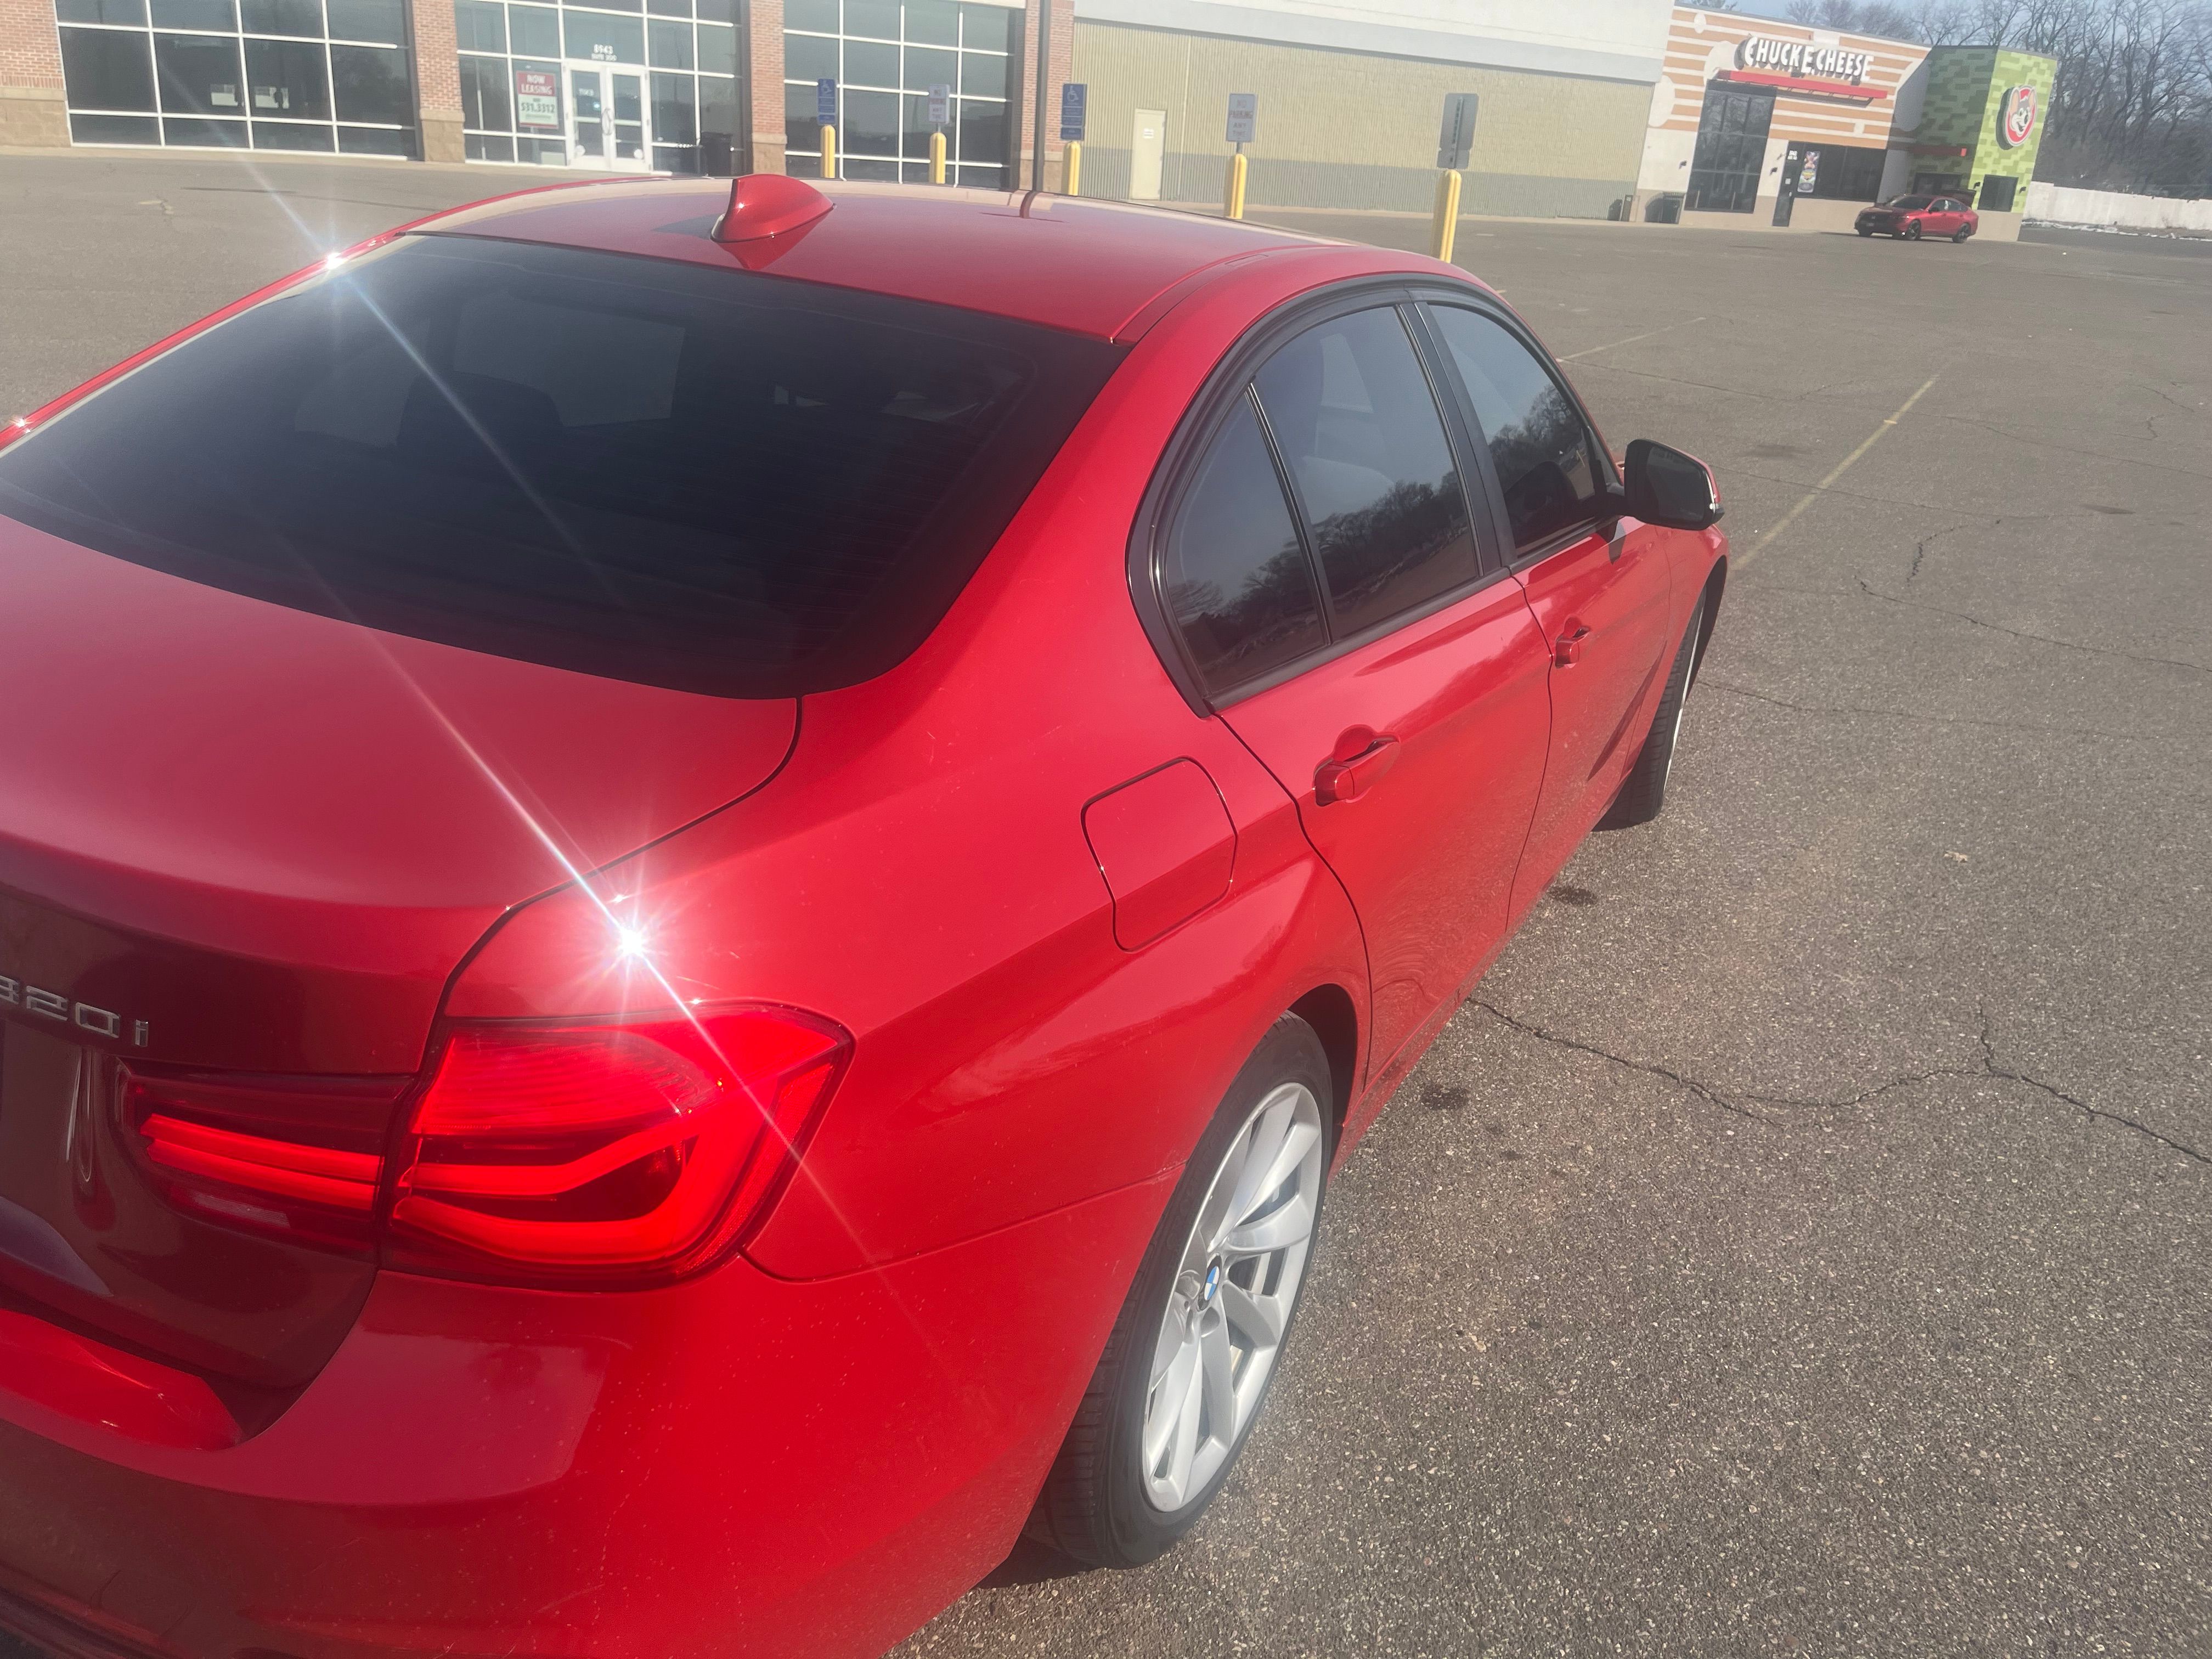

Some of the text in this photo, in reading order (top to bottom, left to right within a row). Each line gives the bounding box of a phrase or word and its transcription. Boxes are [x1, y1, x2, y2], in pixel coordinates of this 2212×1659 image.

[1745, 36, 1803, 67] CHUCK
[1816, 49, 1874, 81] CHEESE
[527, 74, 545, 84] NOW
[521, 83, 553, 95] LEASING
